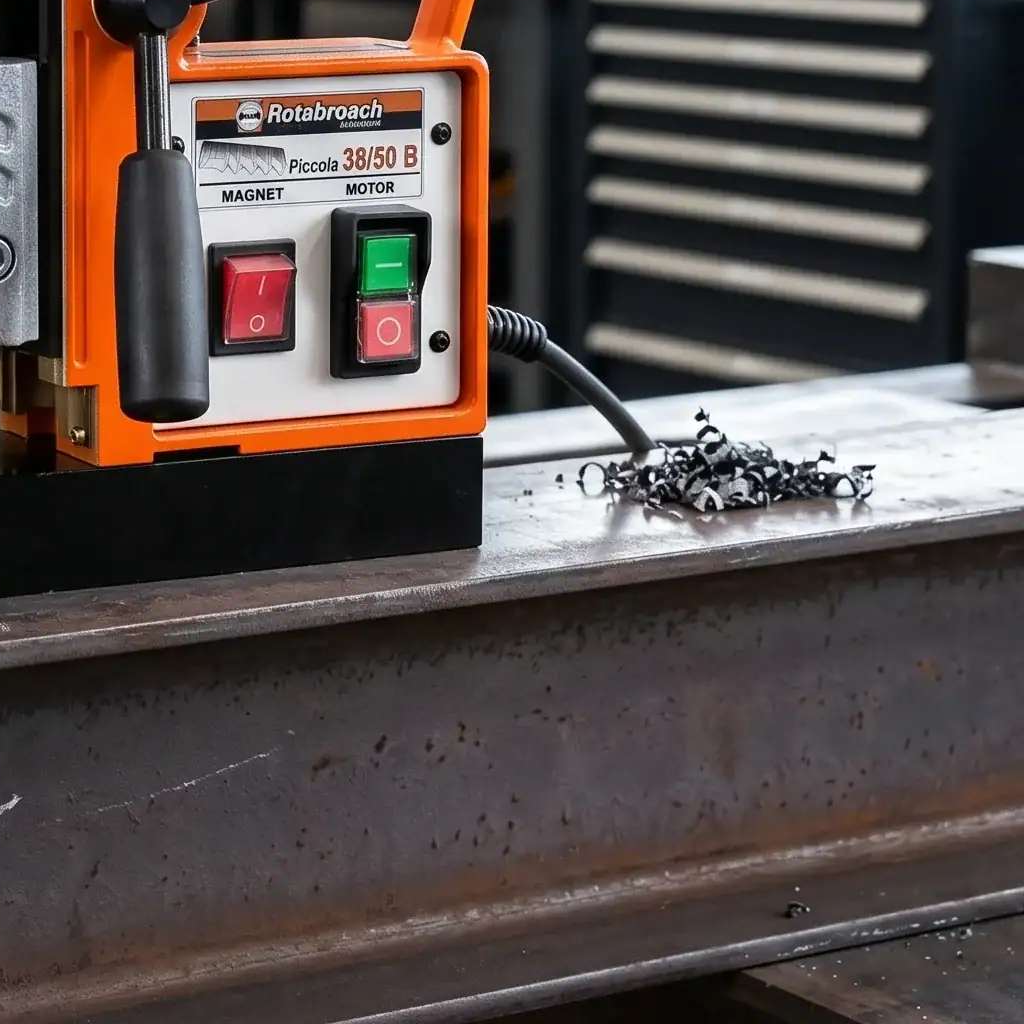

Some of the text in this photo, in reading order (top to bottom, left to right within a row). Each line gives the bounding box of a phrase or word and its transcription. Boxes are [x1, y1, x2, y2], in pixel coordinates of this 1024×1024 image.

[267, 99, 383, 124] Rotabroach
[289, 145, 418, 174] Piccola 38/50 B
[222, 188, 284, 203] MAGNET
[345, 181, 394, 196] MOTOR
